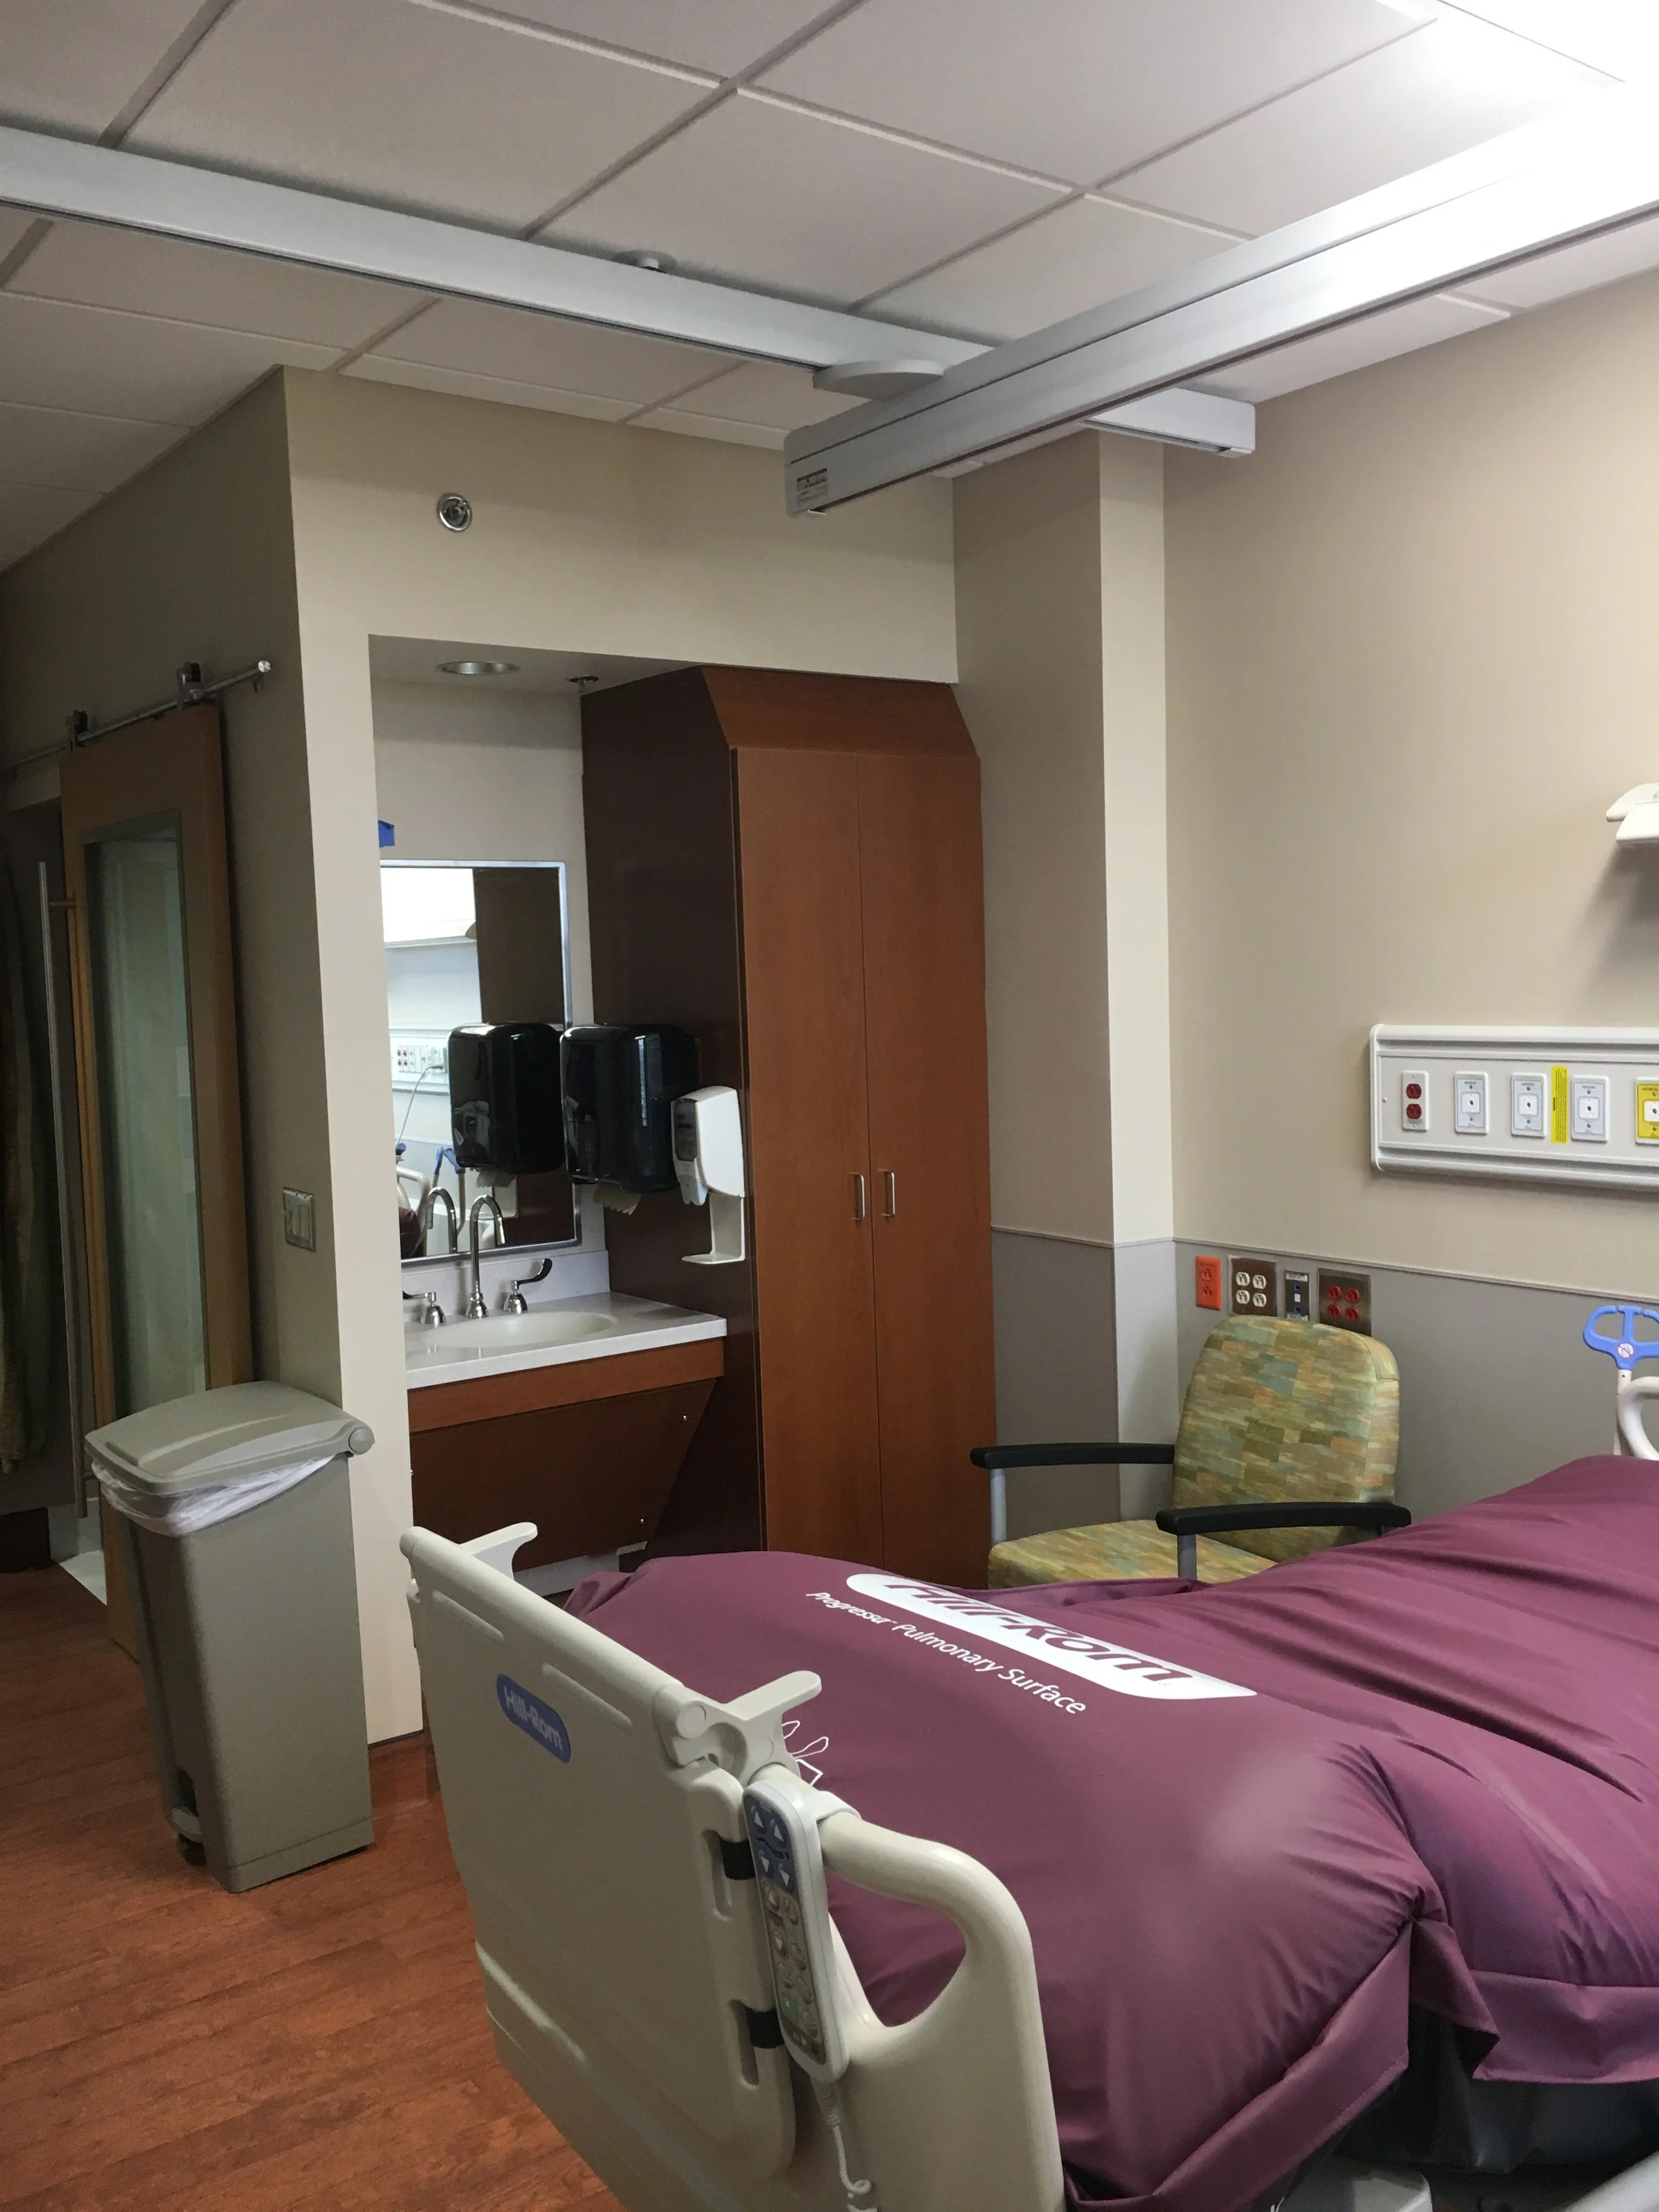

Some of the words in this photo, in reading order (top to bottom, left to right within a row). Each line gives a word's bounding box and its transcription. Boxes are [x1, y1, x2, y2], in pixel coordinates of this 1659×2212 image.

[891, 1623, 1005, 1672] Pulmonary
[997, 1668, 1087, 1714] Surface
[503, 1685, 563, 1753] Hill-Rom
